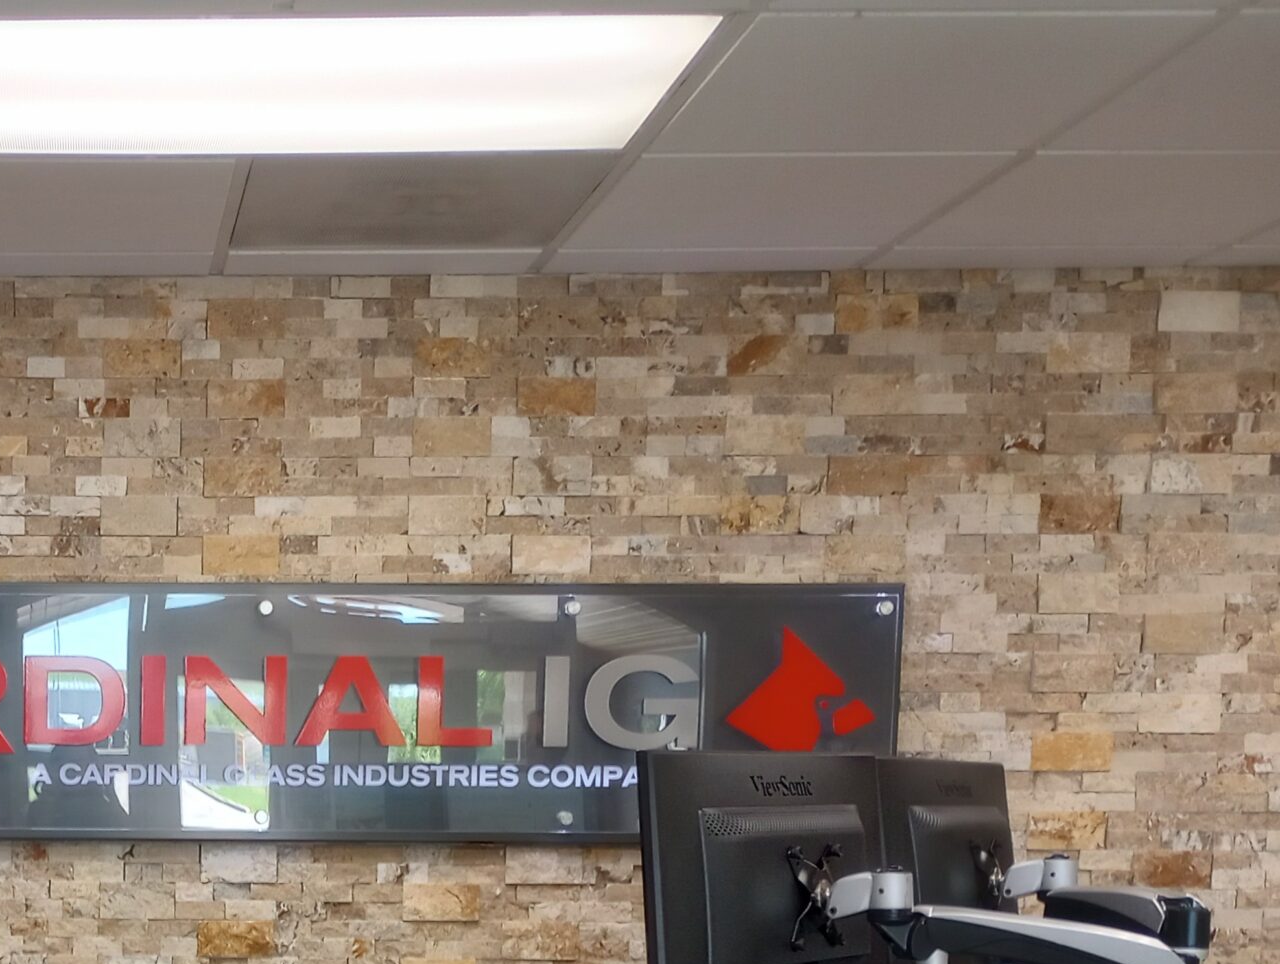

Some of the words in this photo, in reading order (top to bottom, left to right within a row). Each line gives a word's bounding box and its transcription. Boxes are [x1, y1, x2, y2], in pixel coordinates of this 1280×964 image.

[542, 654, 700, 752] IG
[31, 763, 52, 785] A
[58, 763, 214, 786] CARDINAL
[224, 763, 325, 787] GLASS
[333, 764, 520, 788] INDUSTRIES
[526, 764, 639, 788] COMPA
[749, 775, 813, 797] ViewSonic
